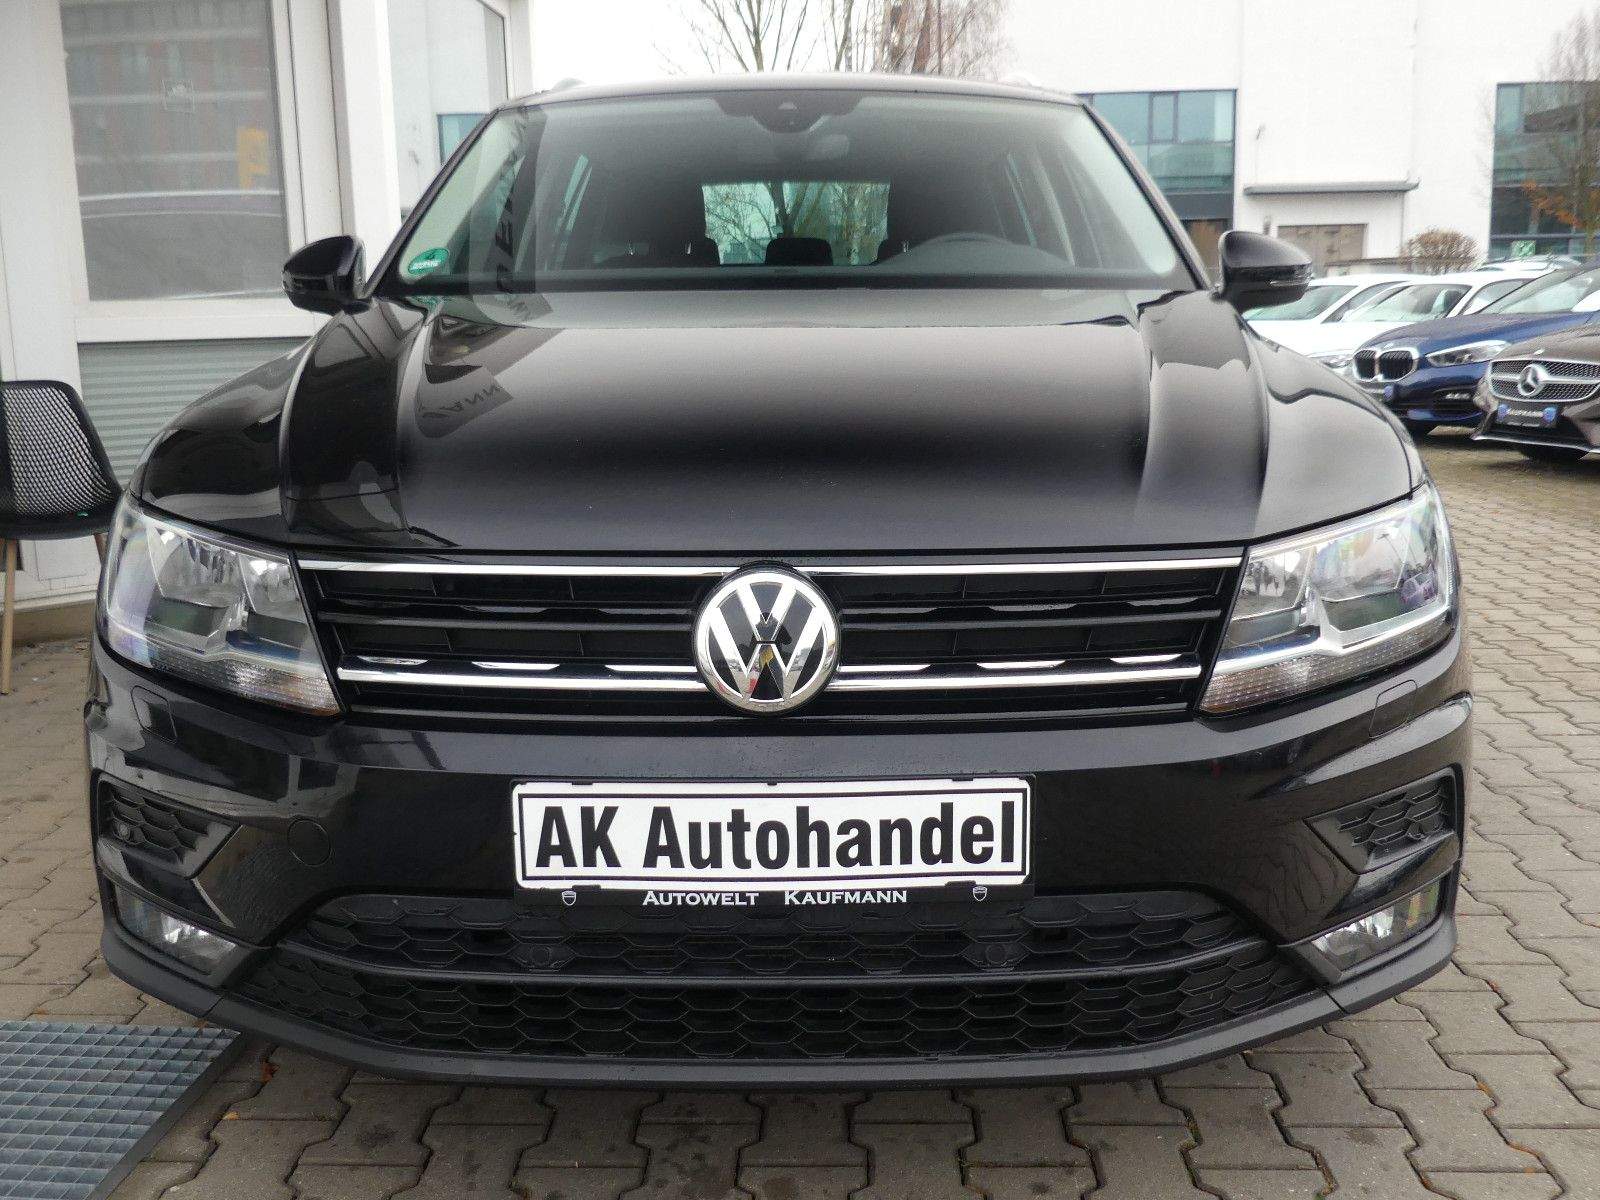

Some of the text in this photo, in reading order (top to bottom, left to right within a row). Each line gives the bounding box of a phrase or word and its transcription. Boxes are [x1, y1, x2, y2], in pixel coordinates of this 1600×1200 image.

[535, 800, 1015, 869] AK Autohandel
[642, 889, 908, 906] AUTOWELT KAUFMANN
